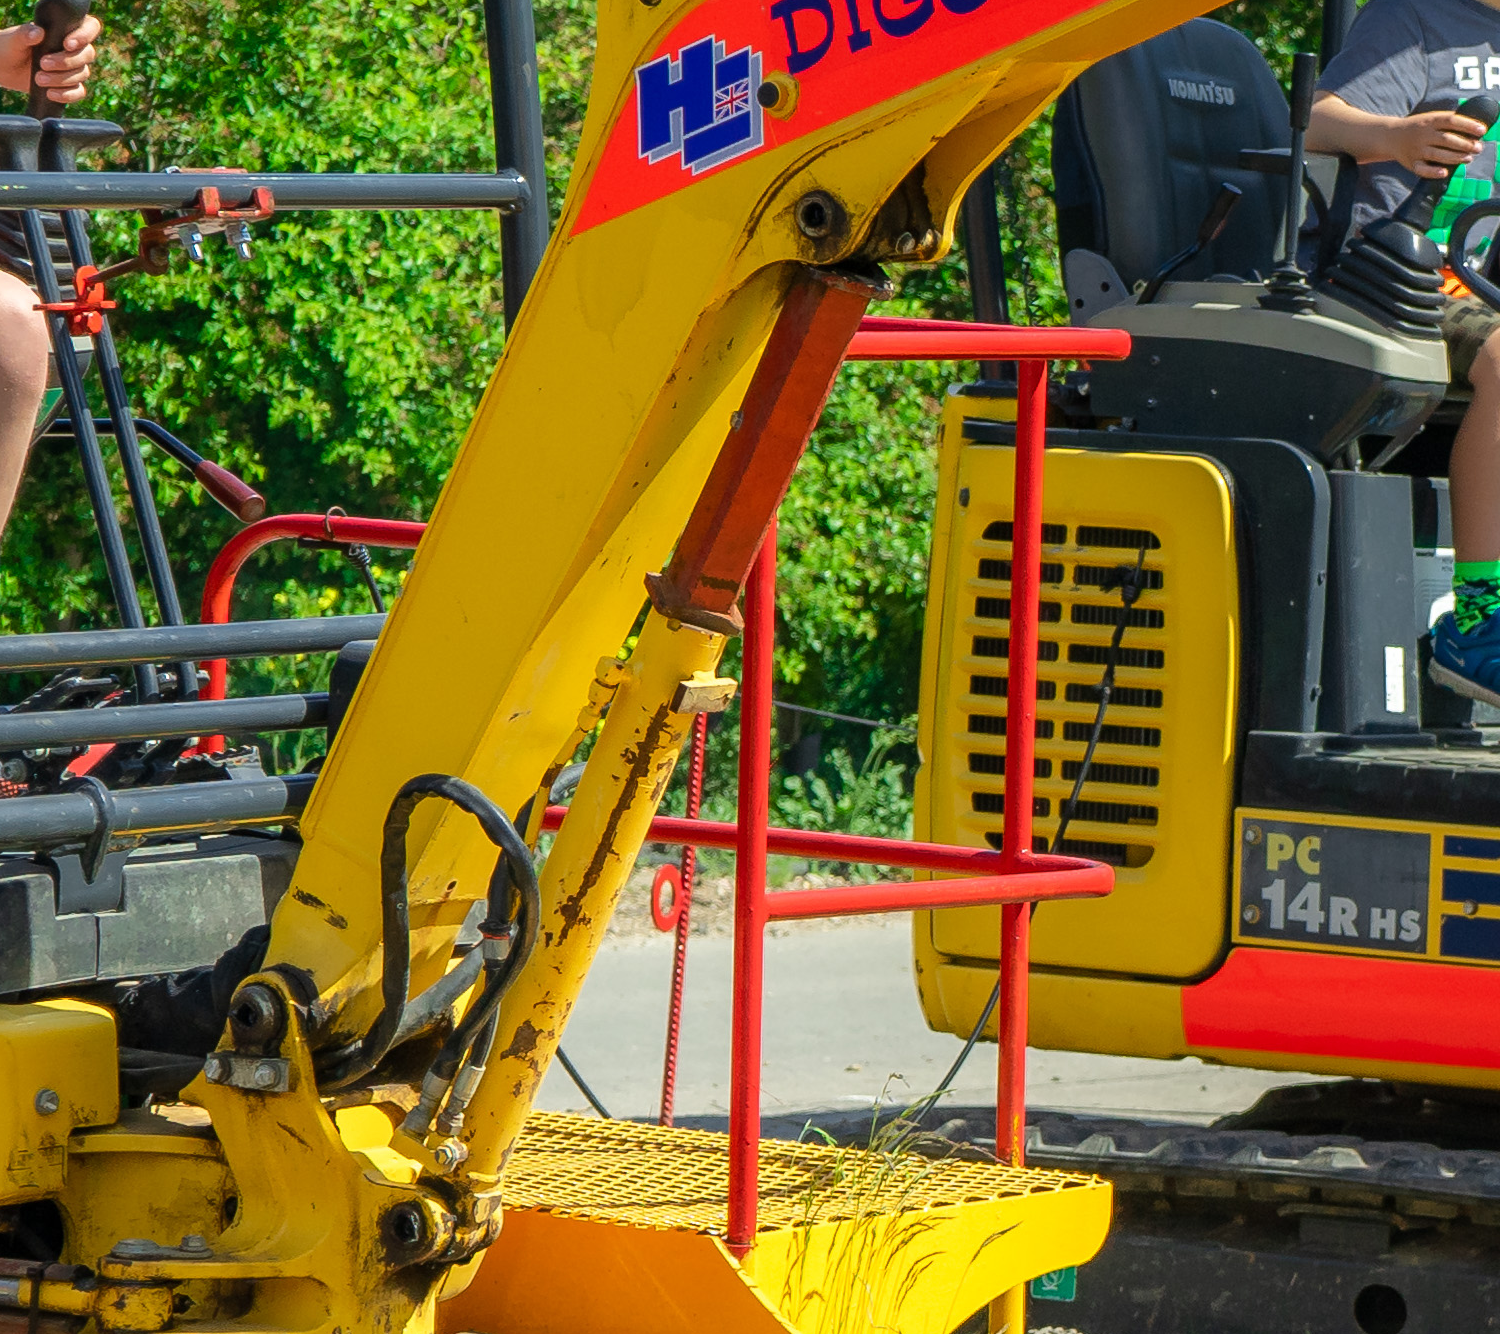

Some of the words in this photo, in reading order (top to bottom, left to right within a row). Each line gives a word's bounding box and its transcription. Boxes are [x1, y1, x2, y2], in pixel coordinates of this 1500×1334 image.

[1168, 79, 1235, 106] KOMATSU
[1266, 832, 1322, 876] PC
[1261, 878, 1359, 937] 14R
[1369, 907, 1421, 942] HS
